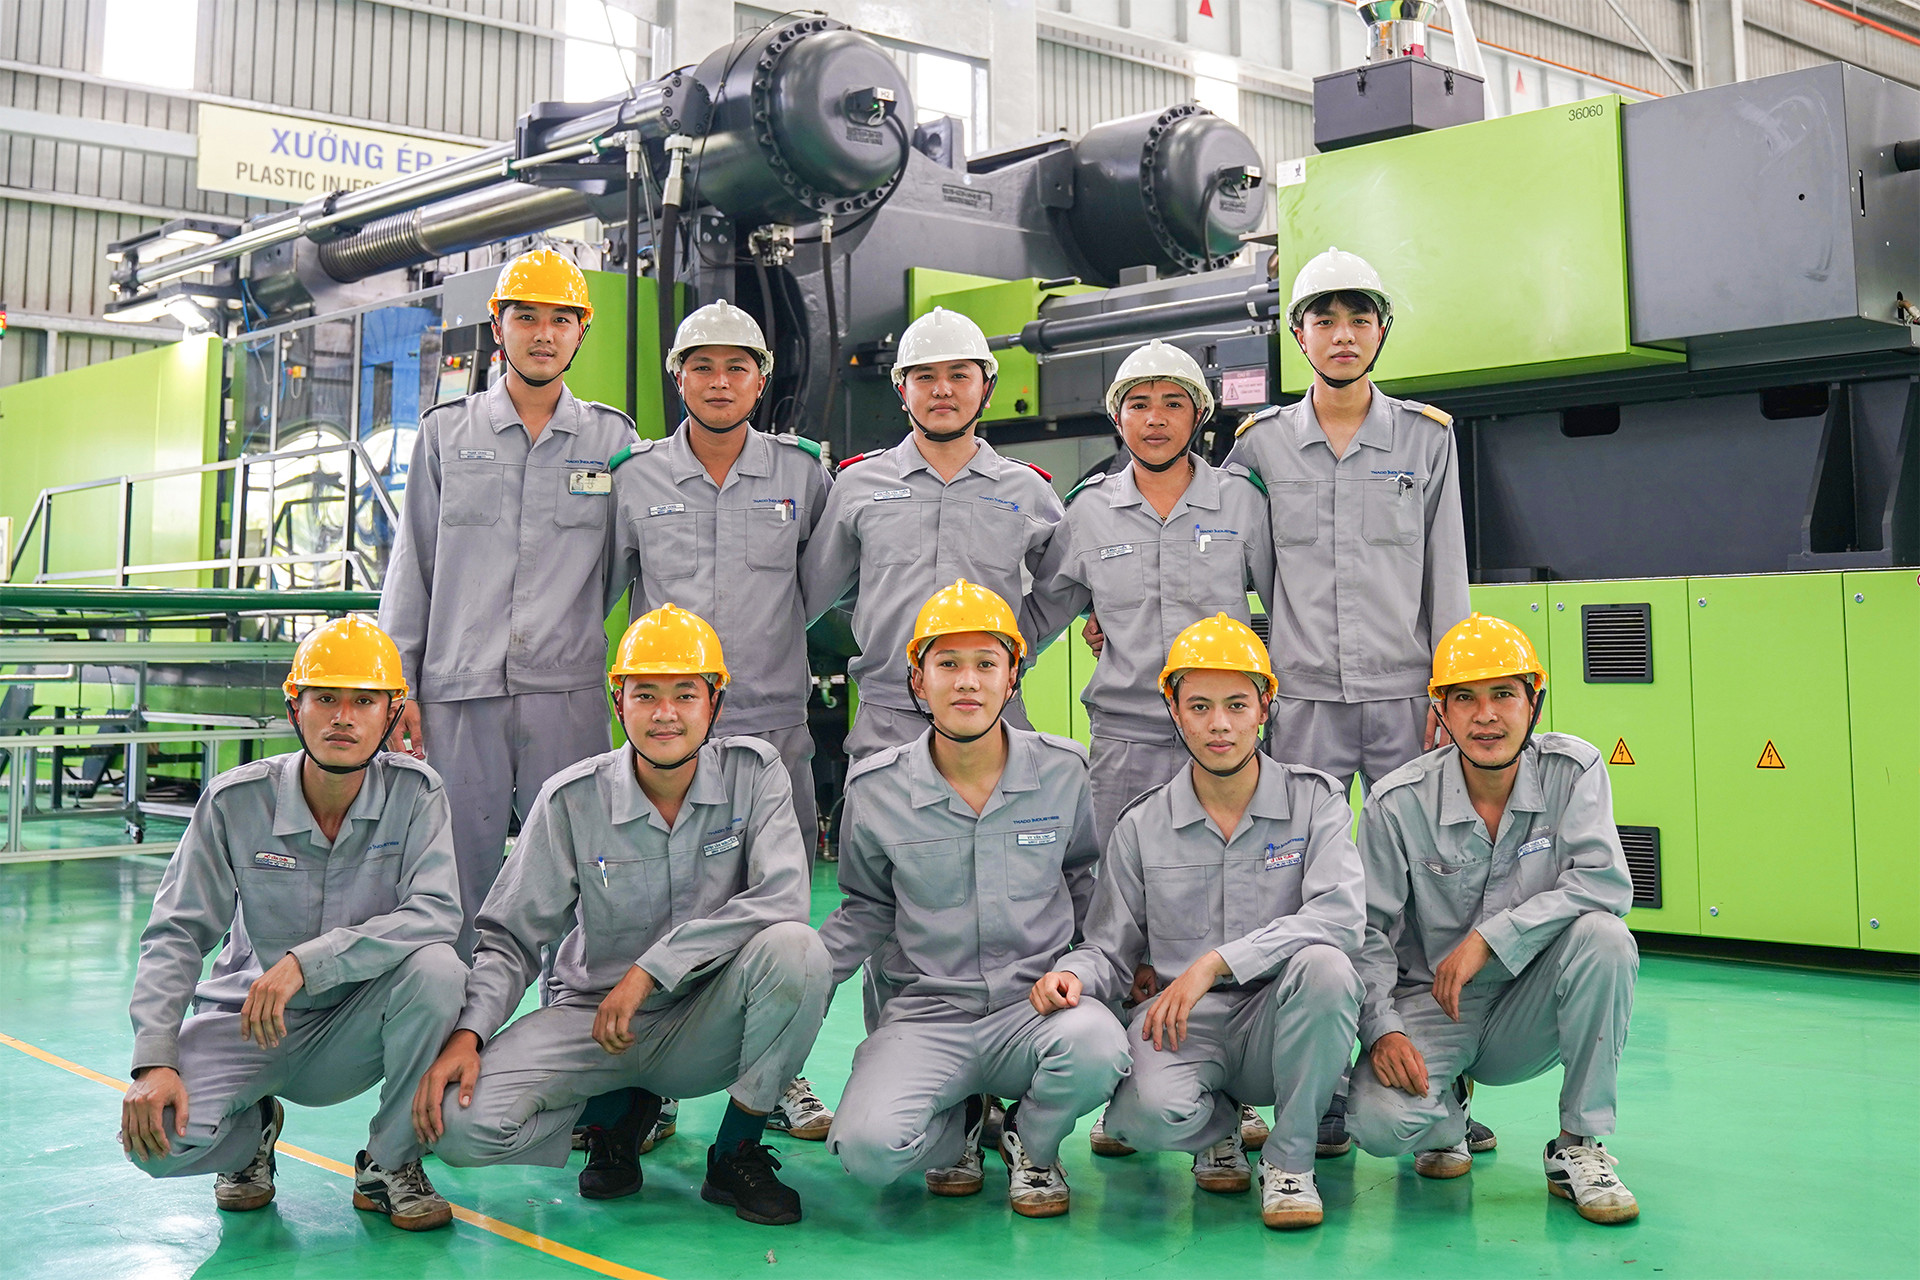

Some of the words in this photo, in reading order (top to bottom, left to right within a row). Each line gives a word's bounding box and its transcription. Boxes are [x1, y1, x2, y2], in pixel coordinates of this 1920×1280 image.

[1568, 104, 1604, 121] 36060
[270, 127, 384, 170] XƯỞNG
[396, 143, 433, 174] ÉP
[236, 161, 315, 191] PLASTIC
[1031, 815, 1060, 823] INDUSTRIES
